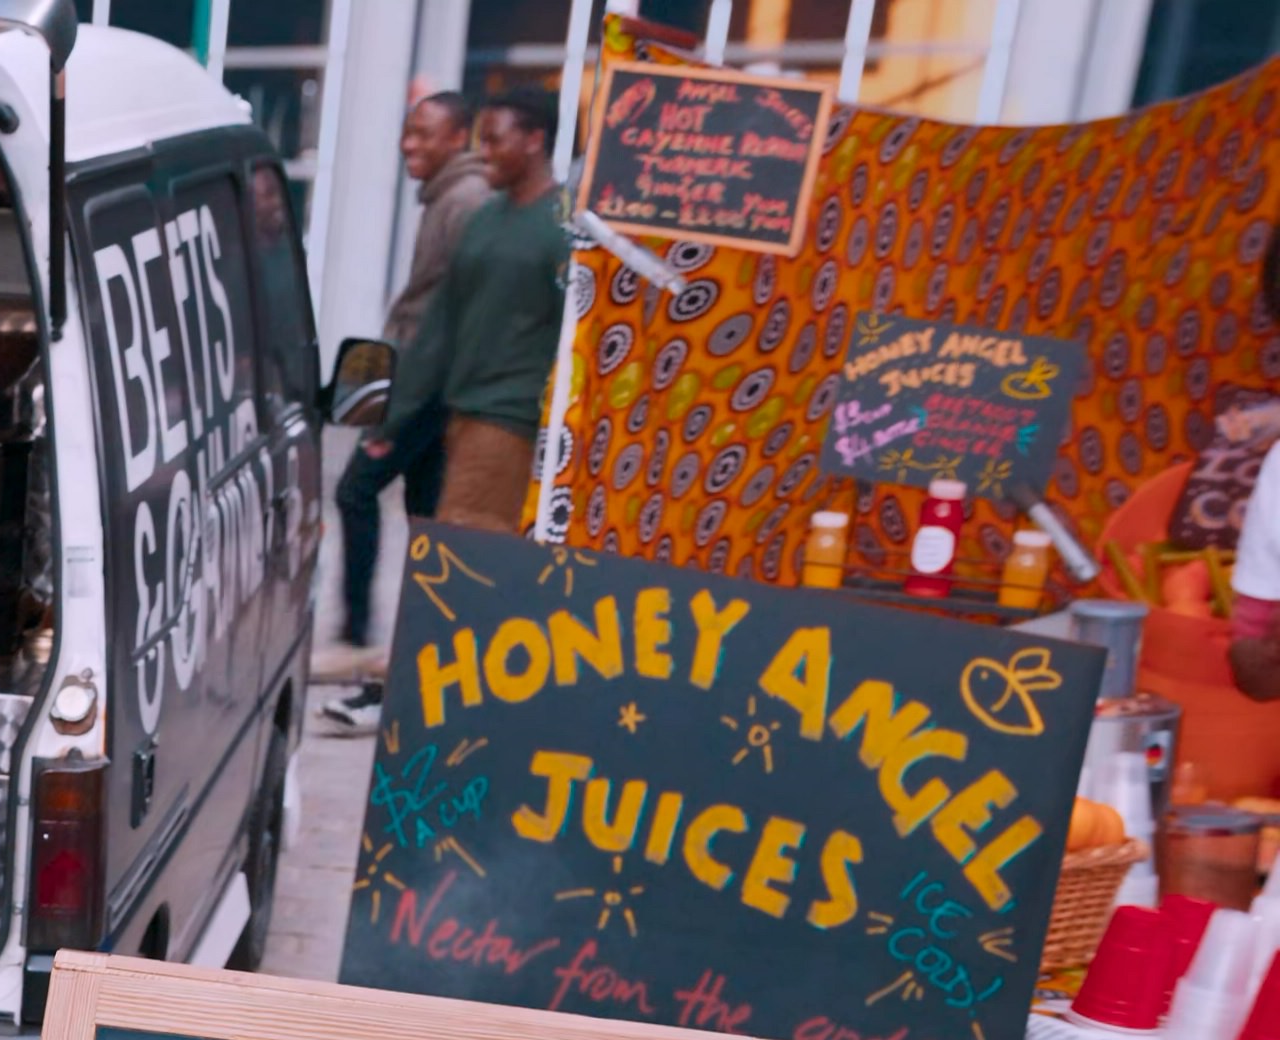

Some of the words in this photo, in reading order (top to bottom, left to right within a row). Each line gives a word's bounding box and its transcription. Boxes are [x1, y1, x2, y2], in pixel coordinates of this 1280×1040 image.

[417, 588, 750, 728] HONEY
[760, 627, 1043, 912] ANGEL
[511, 750, 863, 929] JUICES
[900, 871, 974, 938] ICE
[389, 869, 560, 974] Nectar
[548, 940, 656, 1012] from
[673, 968, 754, 1033] the
